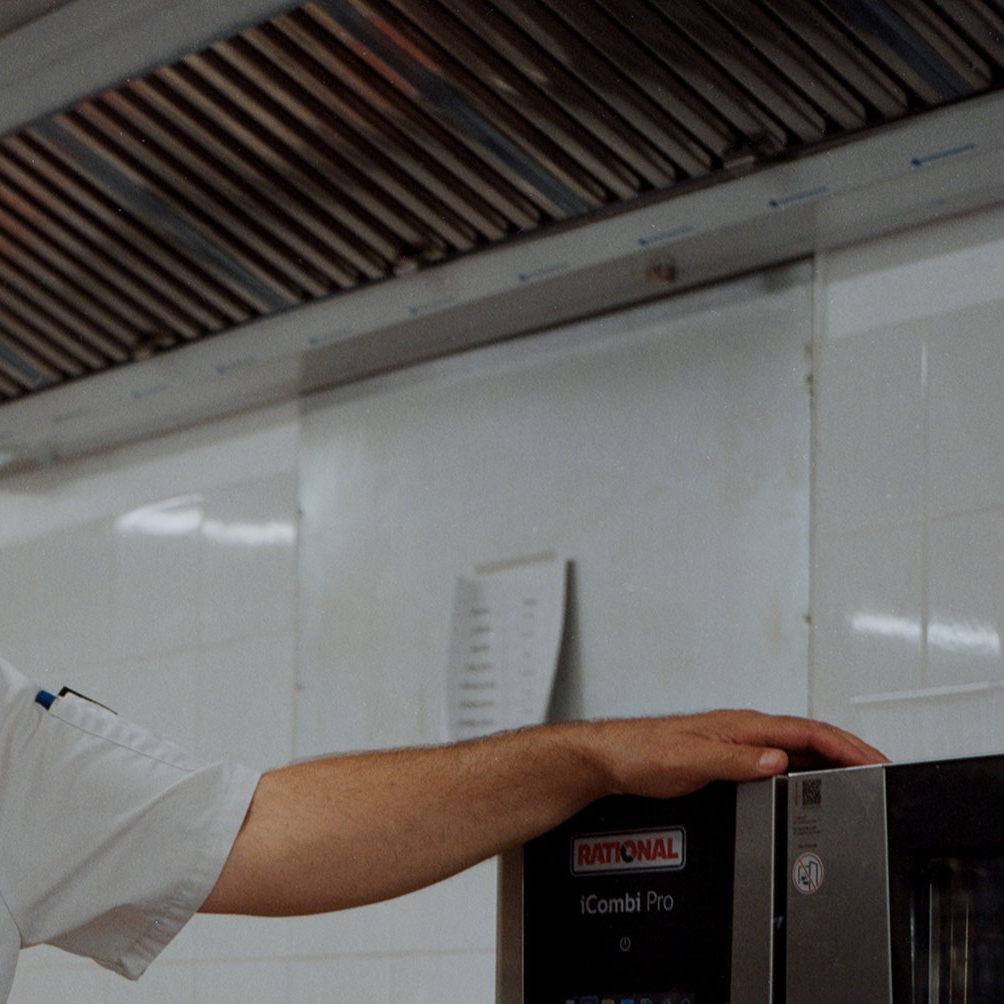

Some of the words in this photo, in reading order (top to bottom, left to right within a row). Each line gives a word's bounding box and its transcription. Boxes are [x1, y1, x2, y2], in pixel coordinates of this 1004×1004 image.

[577, 838, 679, 865] RATIONAL
[580, 891, 641, 915] iCombi
[646, 890, 675, 912] Pro
